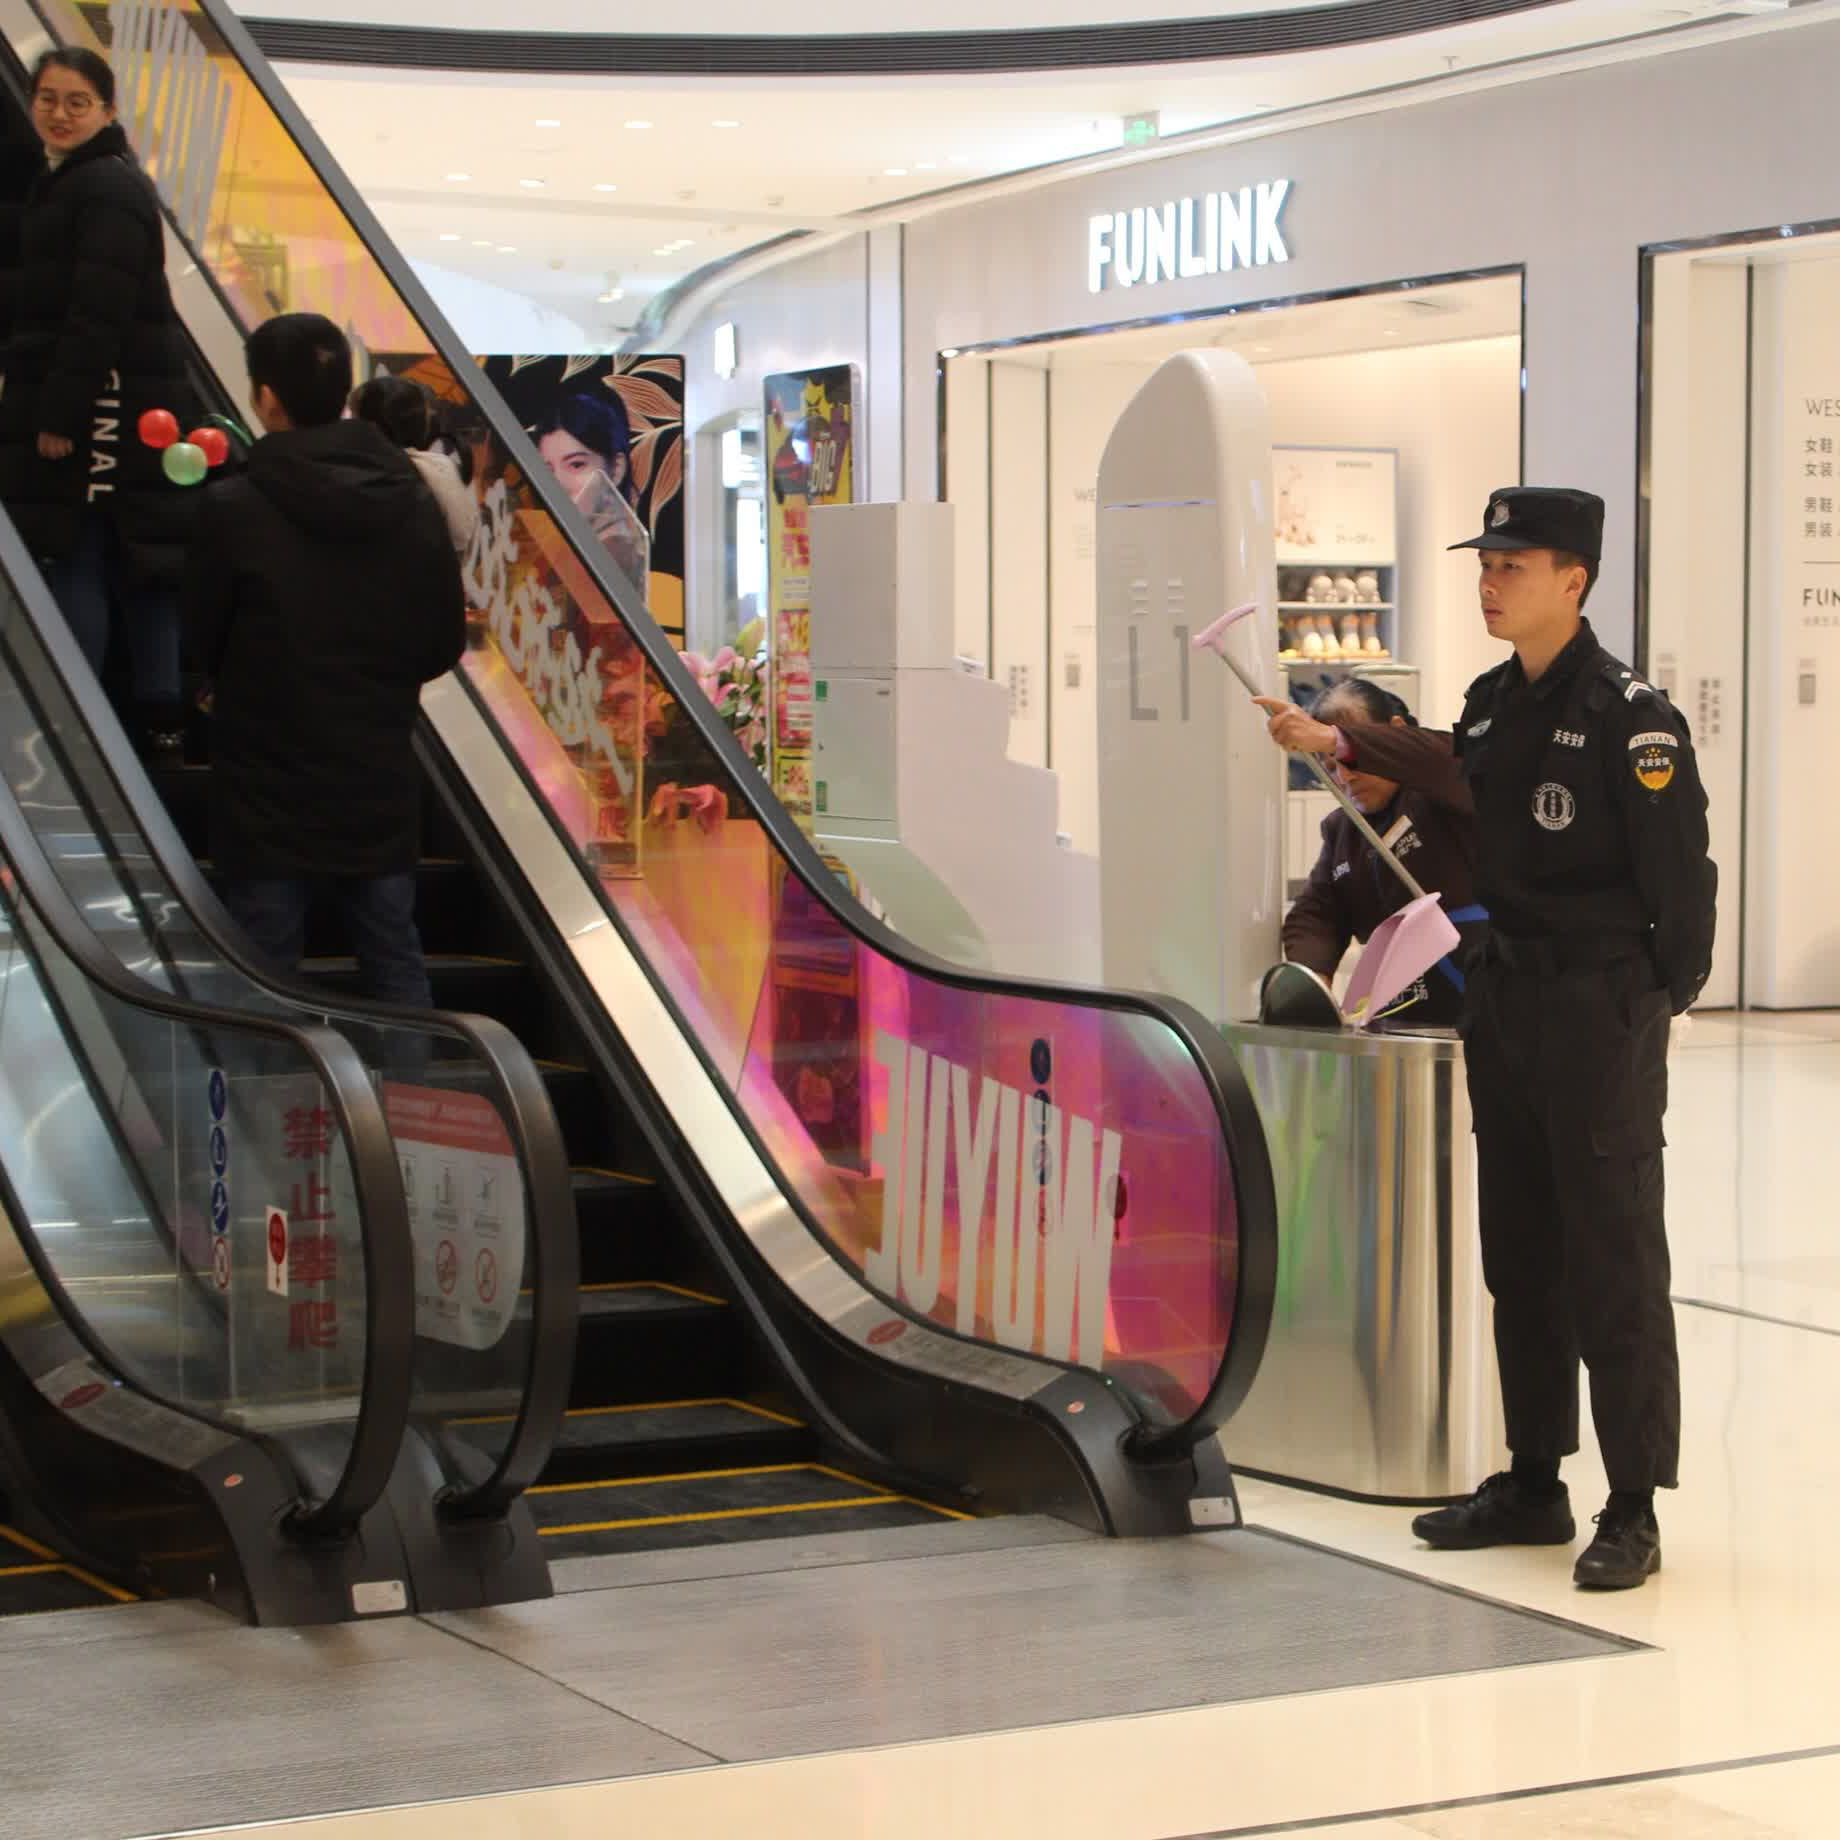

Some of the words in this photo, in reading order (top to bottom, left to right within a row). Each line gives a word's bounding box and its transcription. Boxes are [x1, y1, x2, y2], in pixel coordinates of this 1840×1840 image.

[1087, 178, 1291, 293] FUNLINK
[1552, 729, 1586, 748] 天安安保
[1634, 734, 1672, 745] TIANAN
